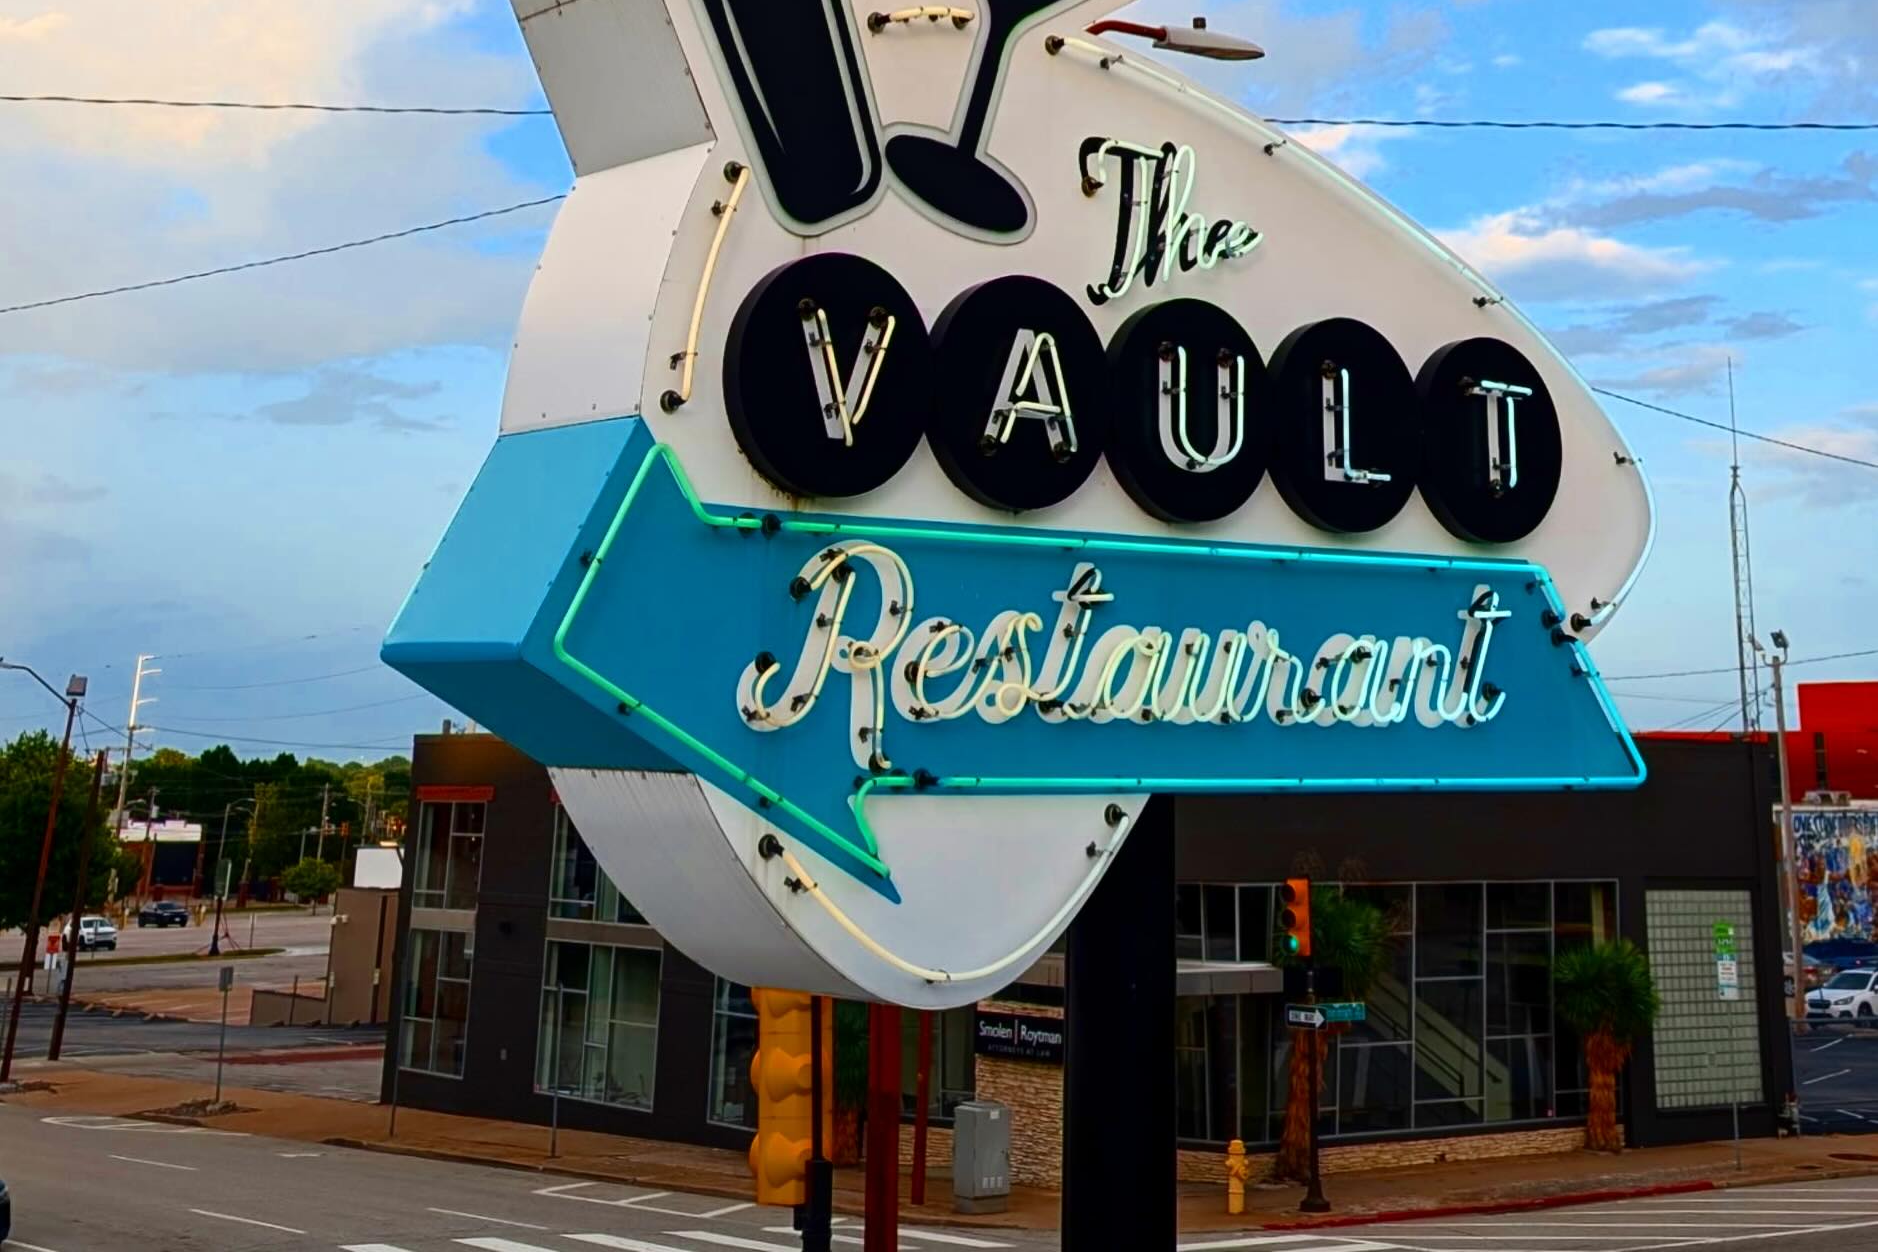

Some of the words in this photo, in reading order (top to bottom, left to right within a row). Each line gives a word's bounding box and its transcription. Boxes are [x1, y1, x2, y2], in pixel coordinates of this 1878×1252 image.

[1079, 136, 1263, 306] The
[799, 297, 1533, 496] VAULT
[736, 539, 1512, 771] Restaurant
[979, 1020, 1013, 1039] Smolen
[1021, 1024, 1062, 1046] Roytman
